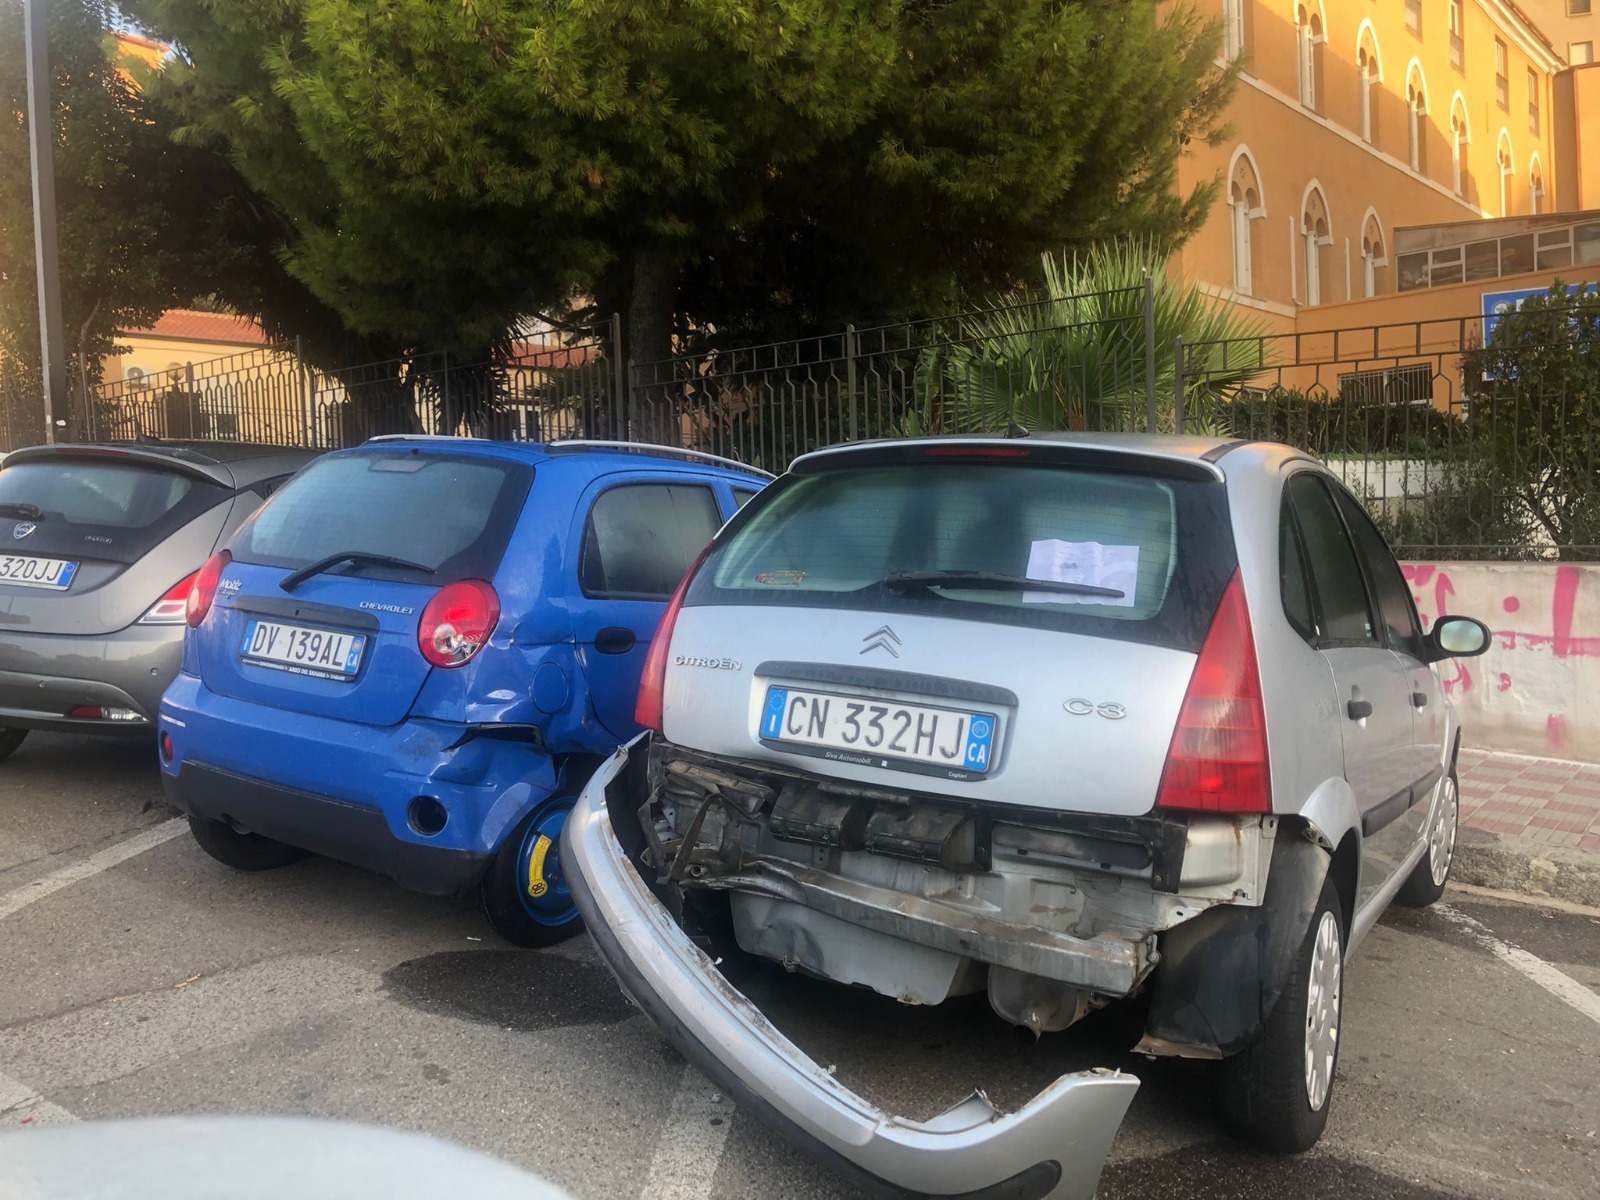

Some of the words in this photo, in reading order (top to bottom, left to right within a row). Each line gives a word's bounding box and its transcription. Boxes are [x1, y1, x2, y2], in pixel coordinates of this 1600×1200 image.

[0, 558, 63, 581] 320JJ
[360, 601, 415, 614] CHEVROLET
[252, 624, 280, 655] DV
[286, 629, 343, 667] 139AL
[347, 653, 358, 668] CA
[674, 655, 743, 671] CITROËN
[1063, 698, 1126, 720] C3
[787, 696, 830, 739] CN
[841, 702, 965, 759] 332HJ
[825, 751, 838, 760] Siva
[838, 753, 873, 765] Automobili
[967, 742, 986, 764] CA
[948, 771, 968, 780] Cagliari
